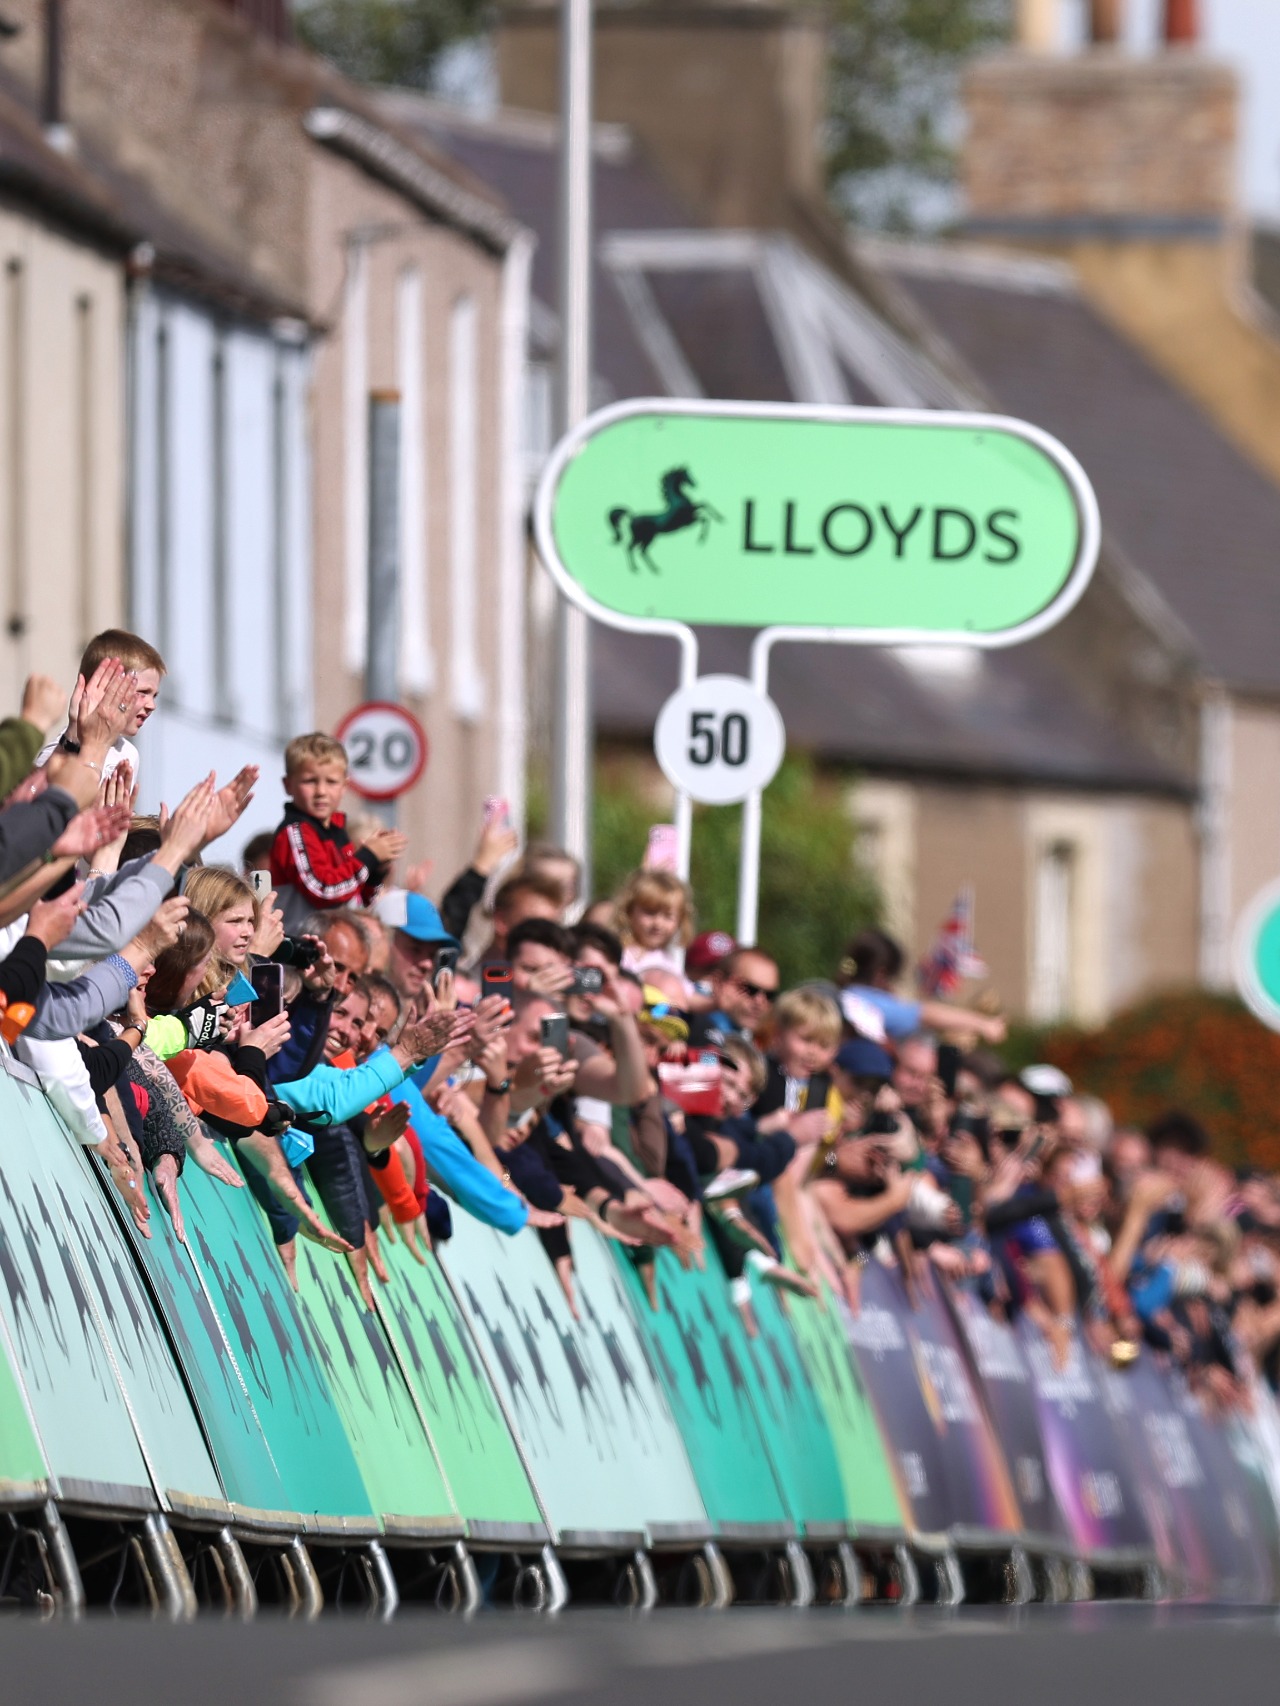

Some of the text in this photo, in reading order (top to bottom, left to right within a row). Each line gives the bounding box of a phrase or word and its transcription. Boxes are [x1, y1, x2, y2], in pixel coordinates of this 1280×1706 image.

[743, 497, 1021, 564] LLOYDS
[350, 731, 413, 772] 20
[688, 711, 749, 767] 50
